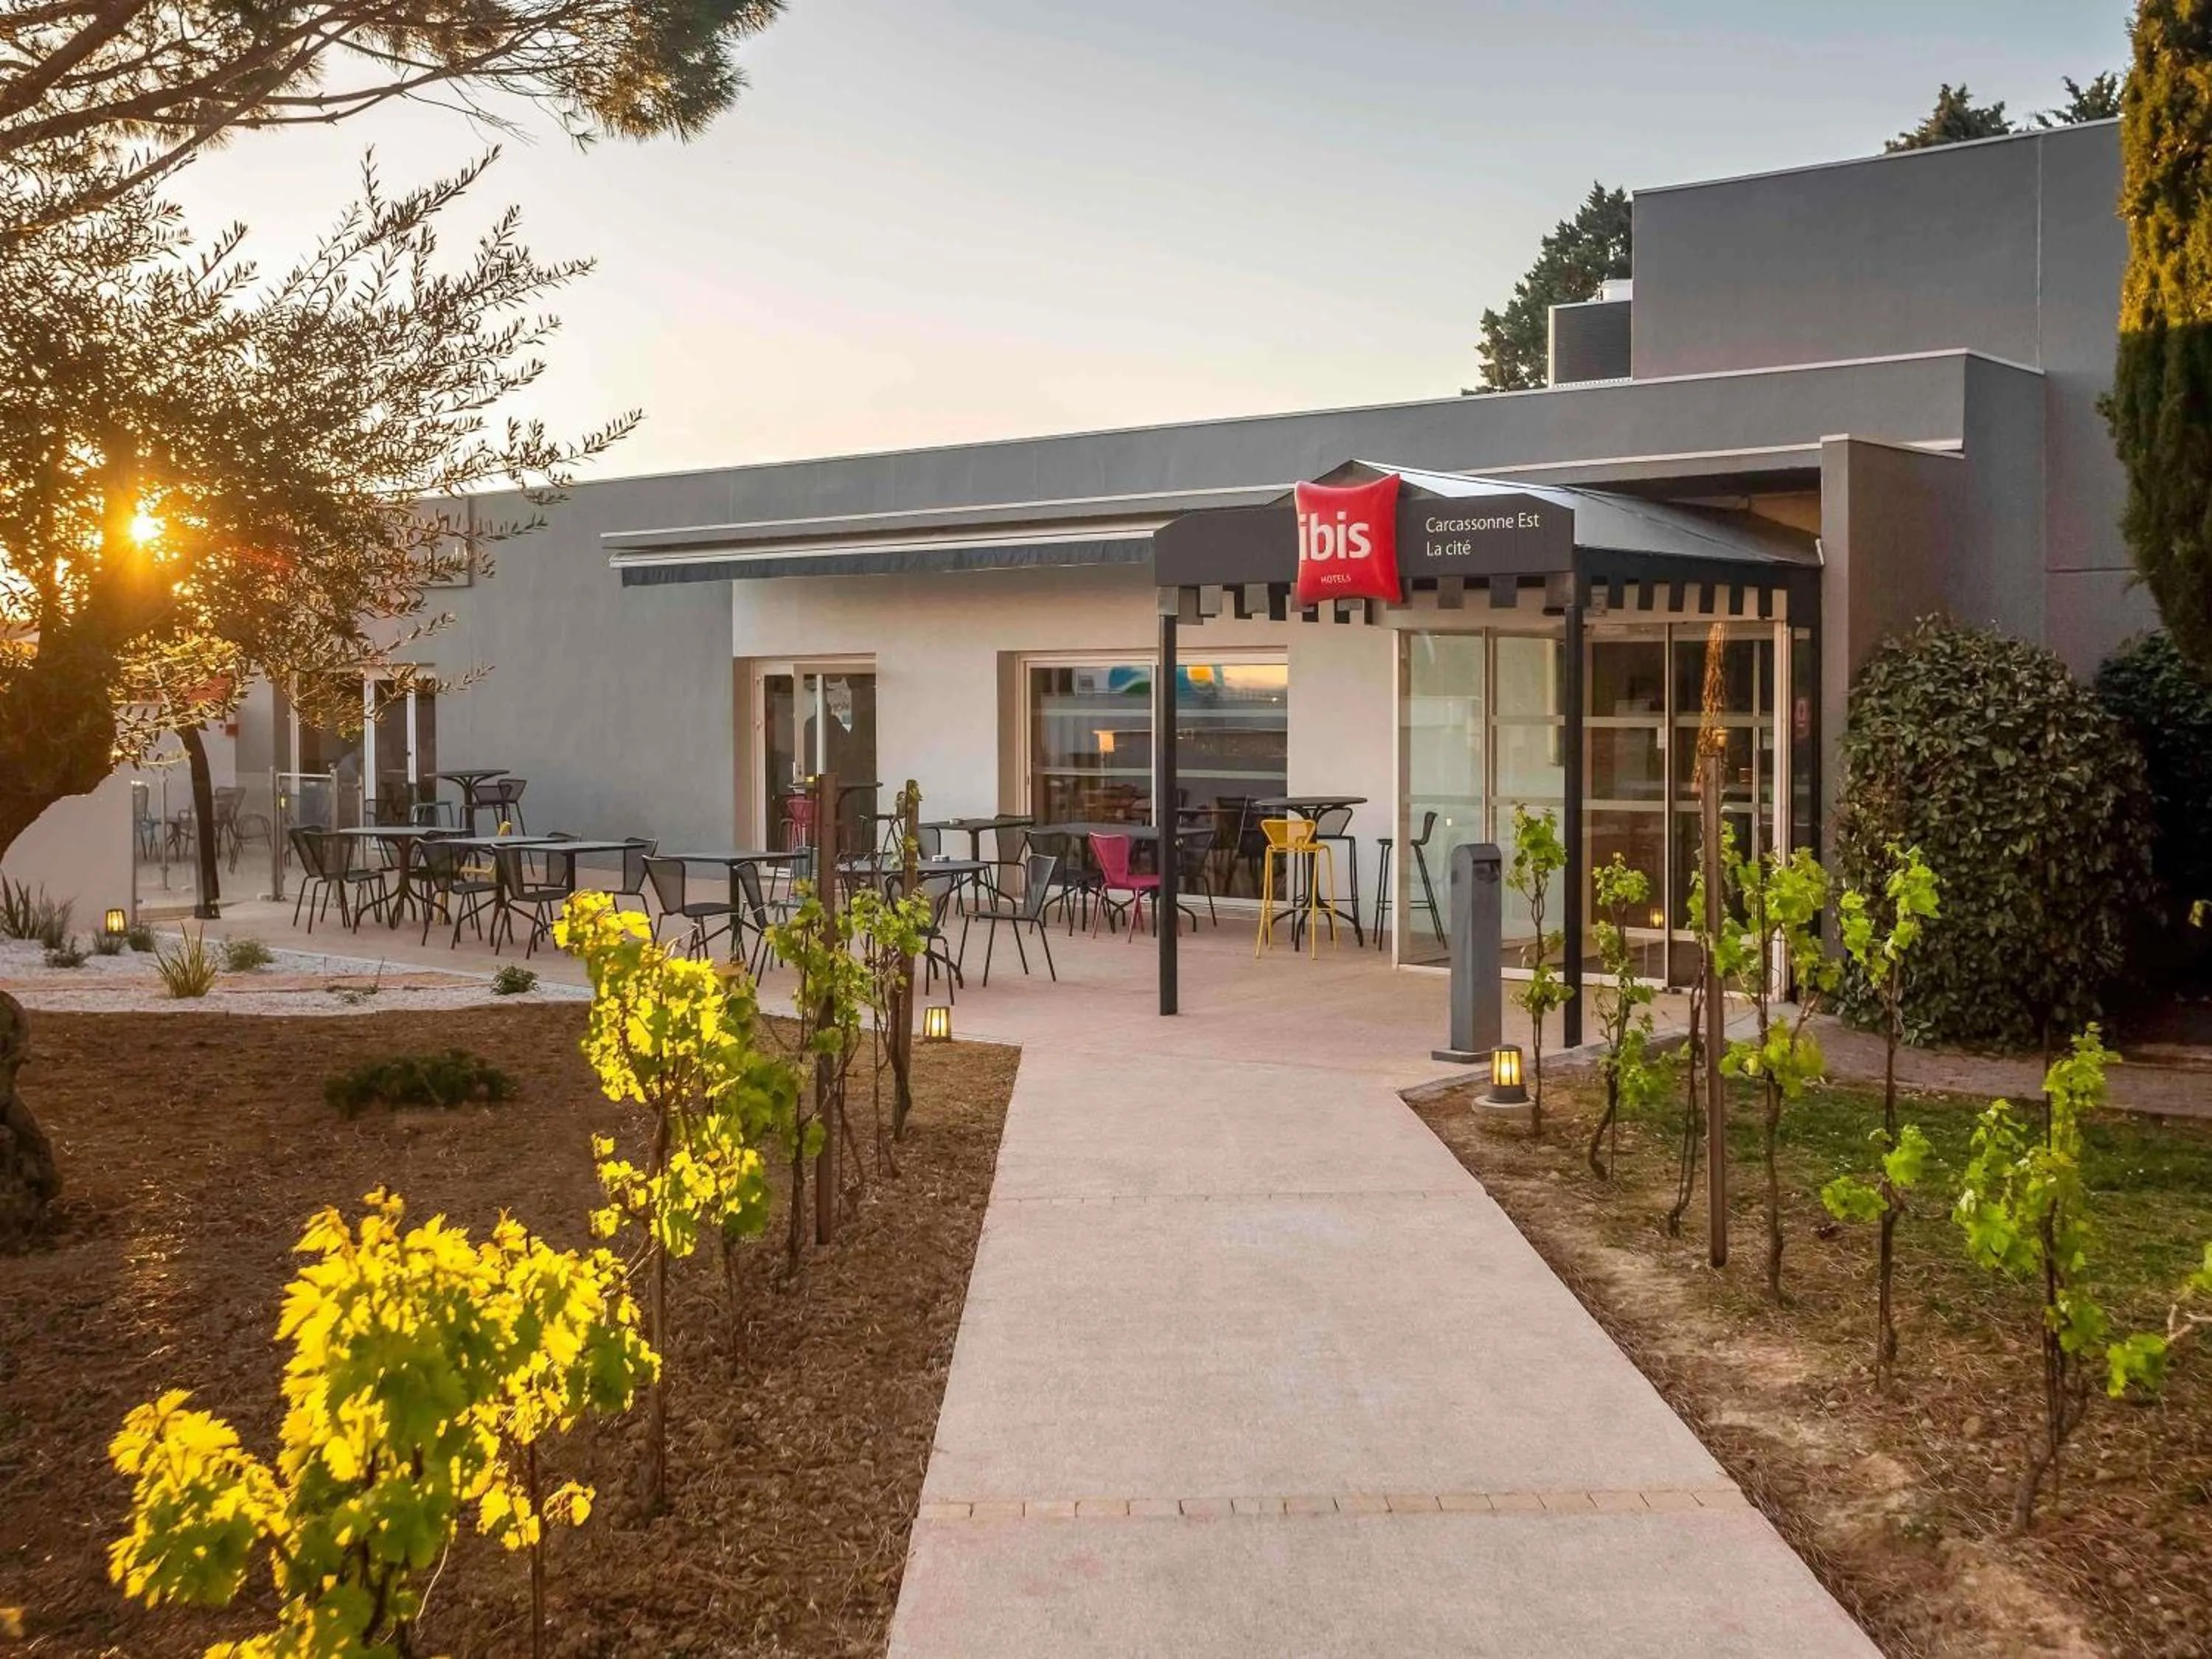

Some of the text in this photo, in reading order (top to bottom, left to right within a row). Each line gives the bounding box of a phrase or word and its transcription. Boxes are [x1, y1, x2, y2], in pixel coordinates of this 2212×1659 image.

[1425, 512, 1540, 532] Carcassonne Est
[1298, 511, 1372, 561] ibis
[1426, 540, 1472, 556] La cité
[1321, 574, 1352, 584] HOTELS
